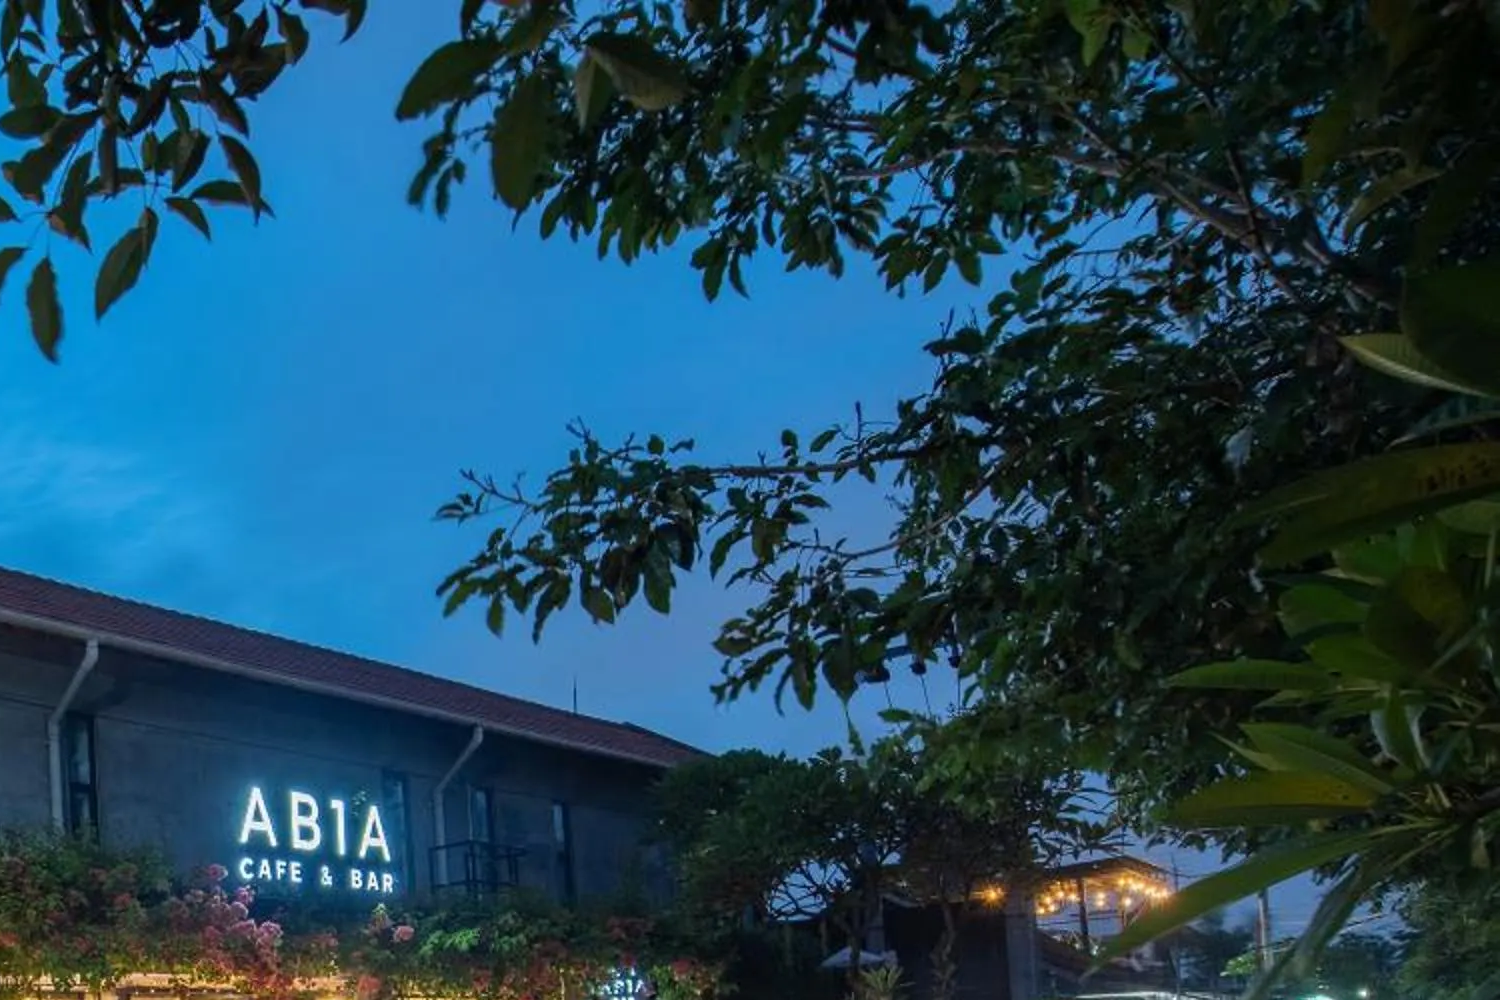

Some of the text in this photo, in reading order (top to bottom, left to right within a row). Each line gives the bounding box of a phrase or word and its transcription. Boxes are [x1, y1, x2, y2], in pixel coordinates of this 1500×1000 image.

[239, 857, 394, 893] CAFE & BAR
